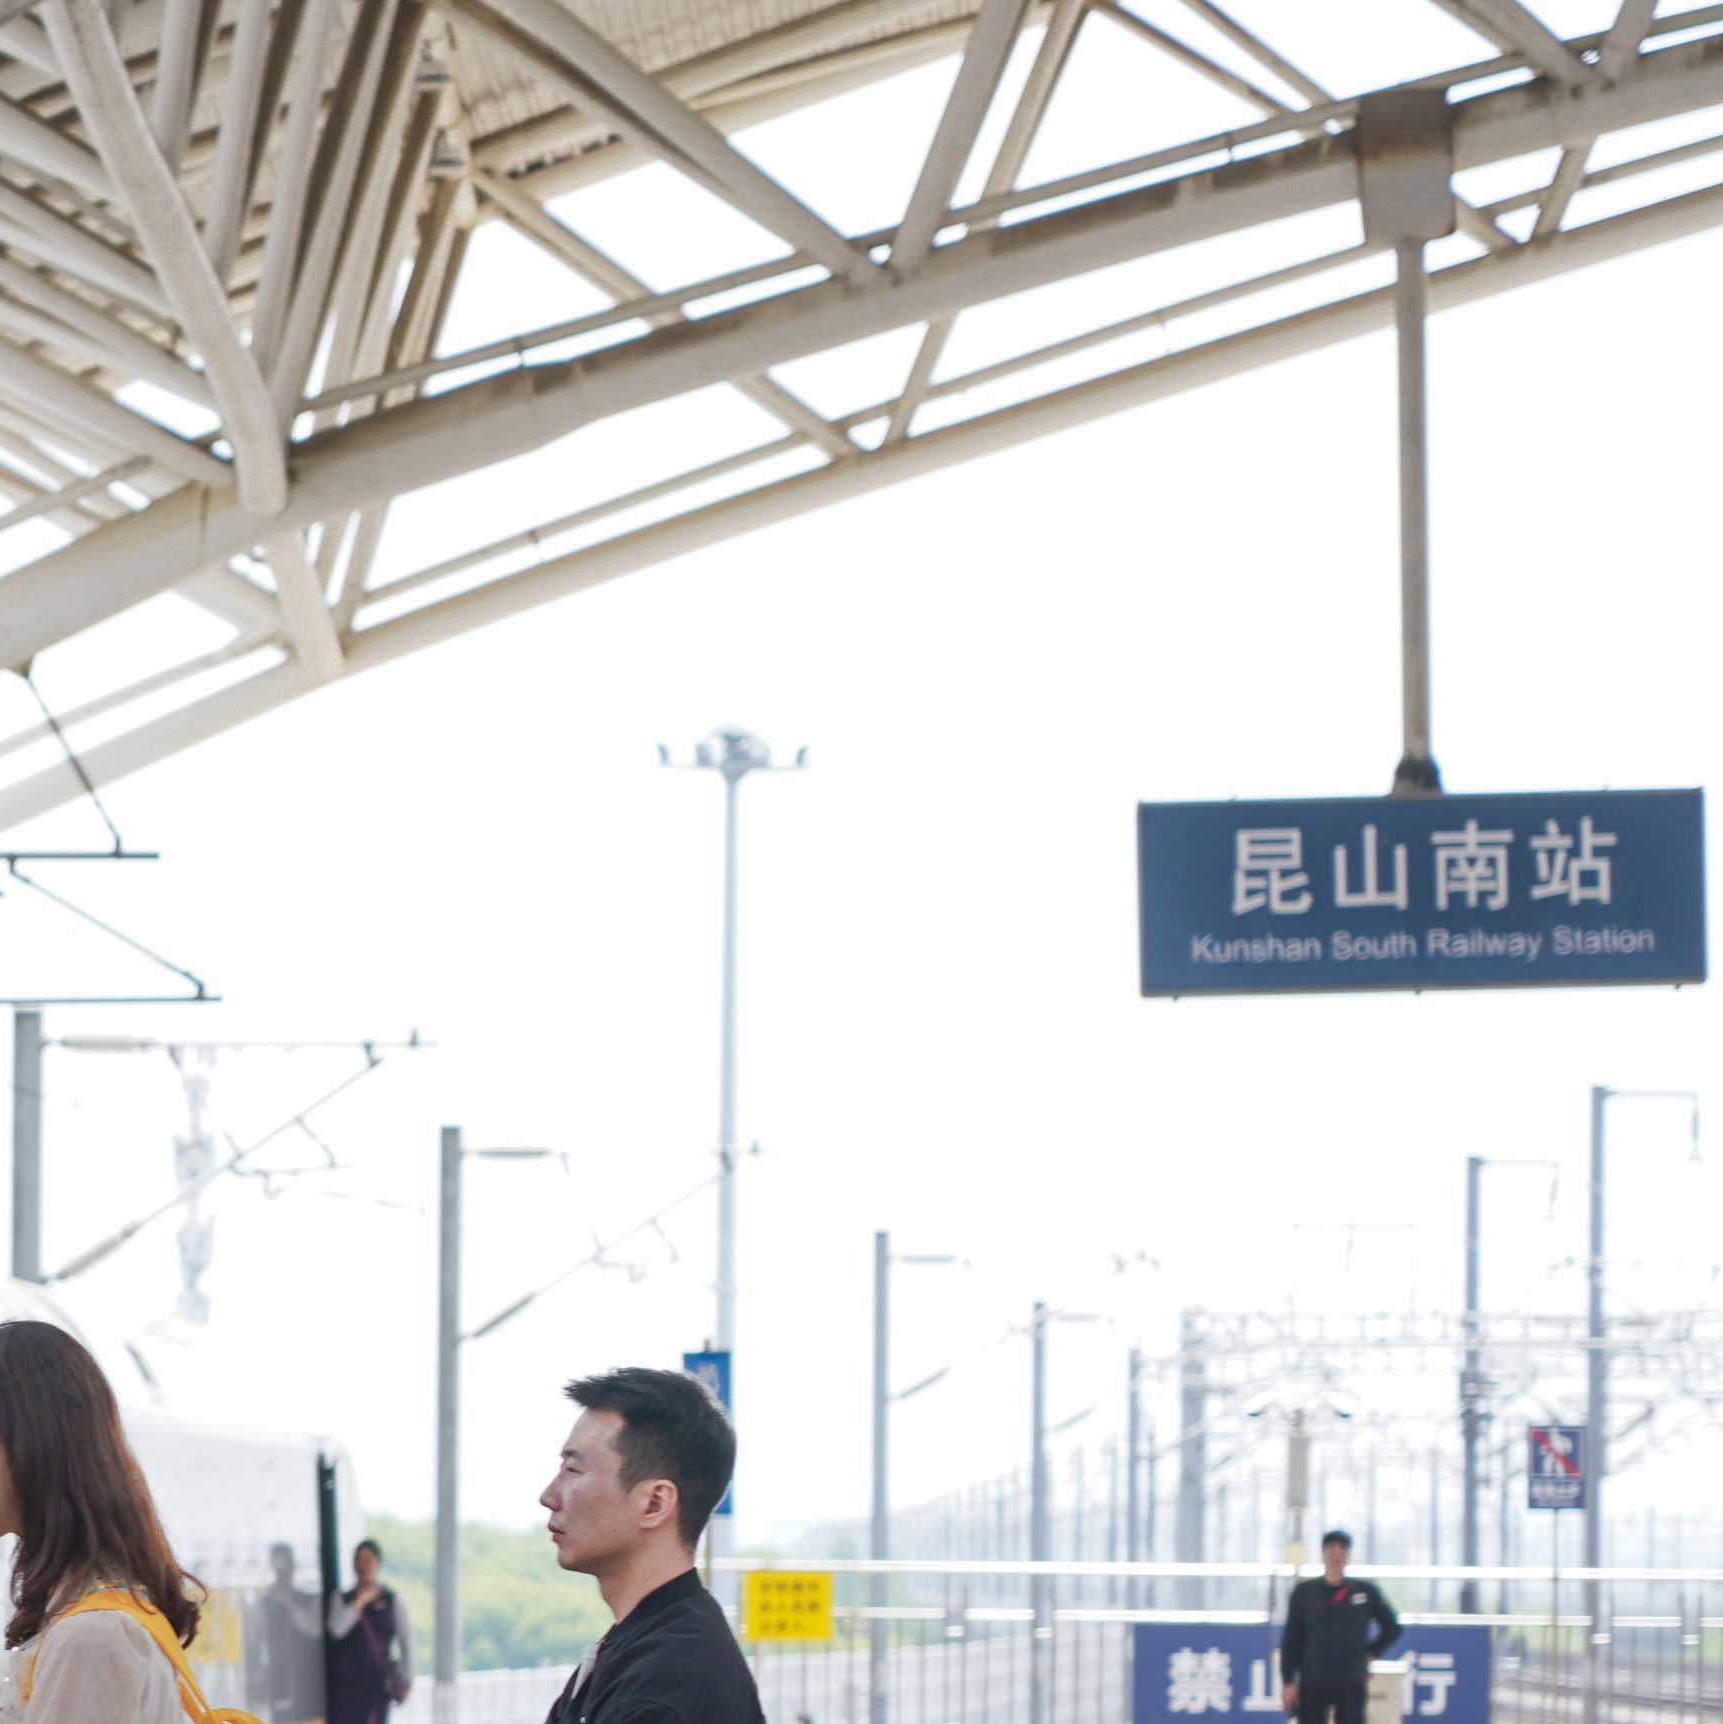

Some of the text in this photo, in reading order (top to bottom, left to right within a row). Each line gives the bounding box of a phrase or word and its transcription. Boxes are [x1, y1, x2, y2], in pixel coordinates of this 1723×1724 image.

[1231, 815, 1617, 916] 昆山南站
[1191, 923, 1656, 964] Kunshan South Railway Station
[1168, 1647, 1456, 1717] 禁止行
